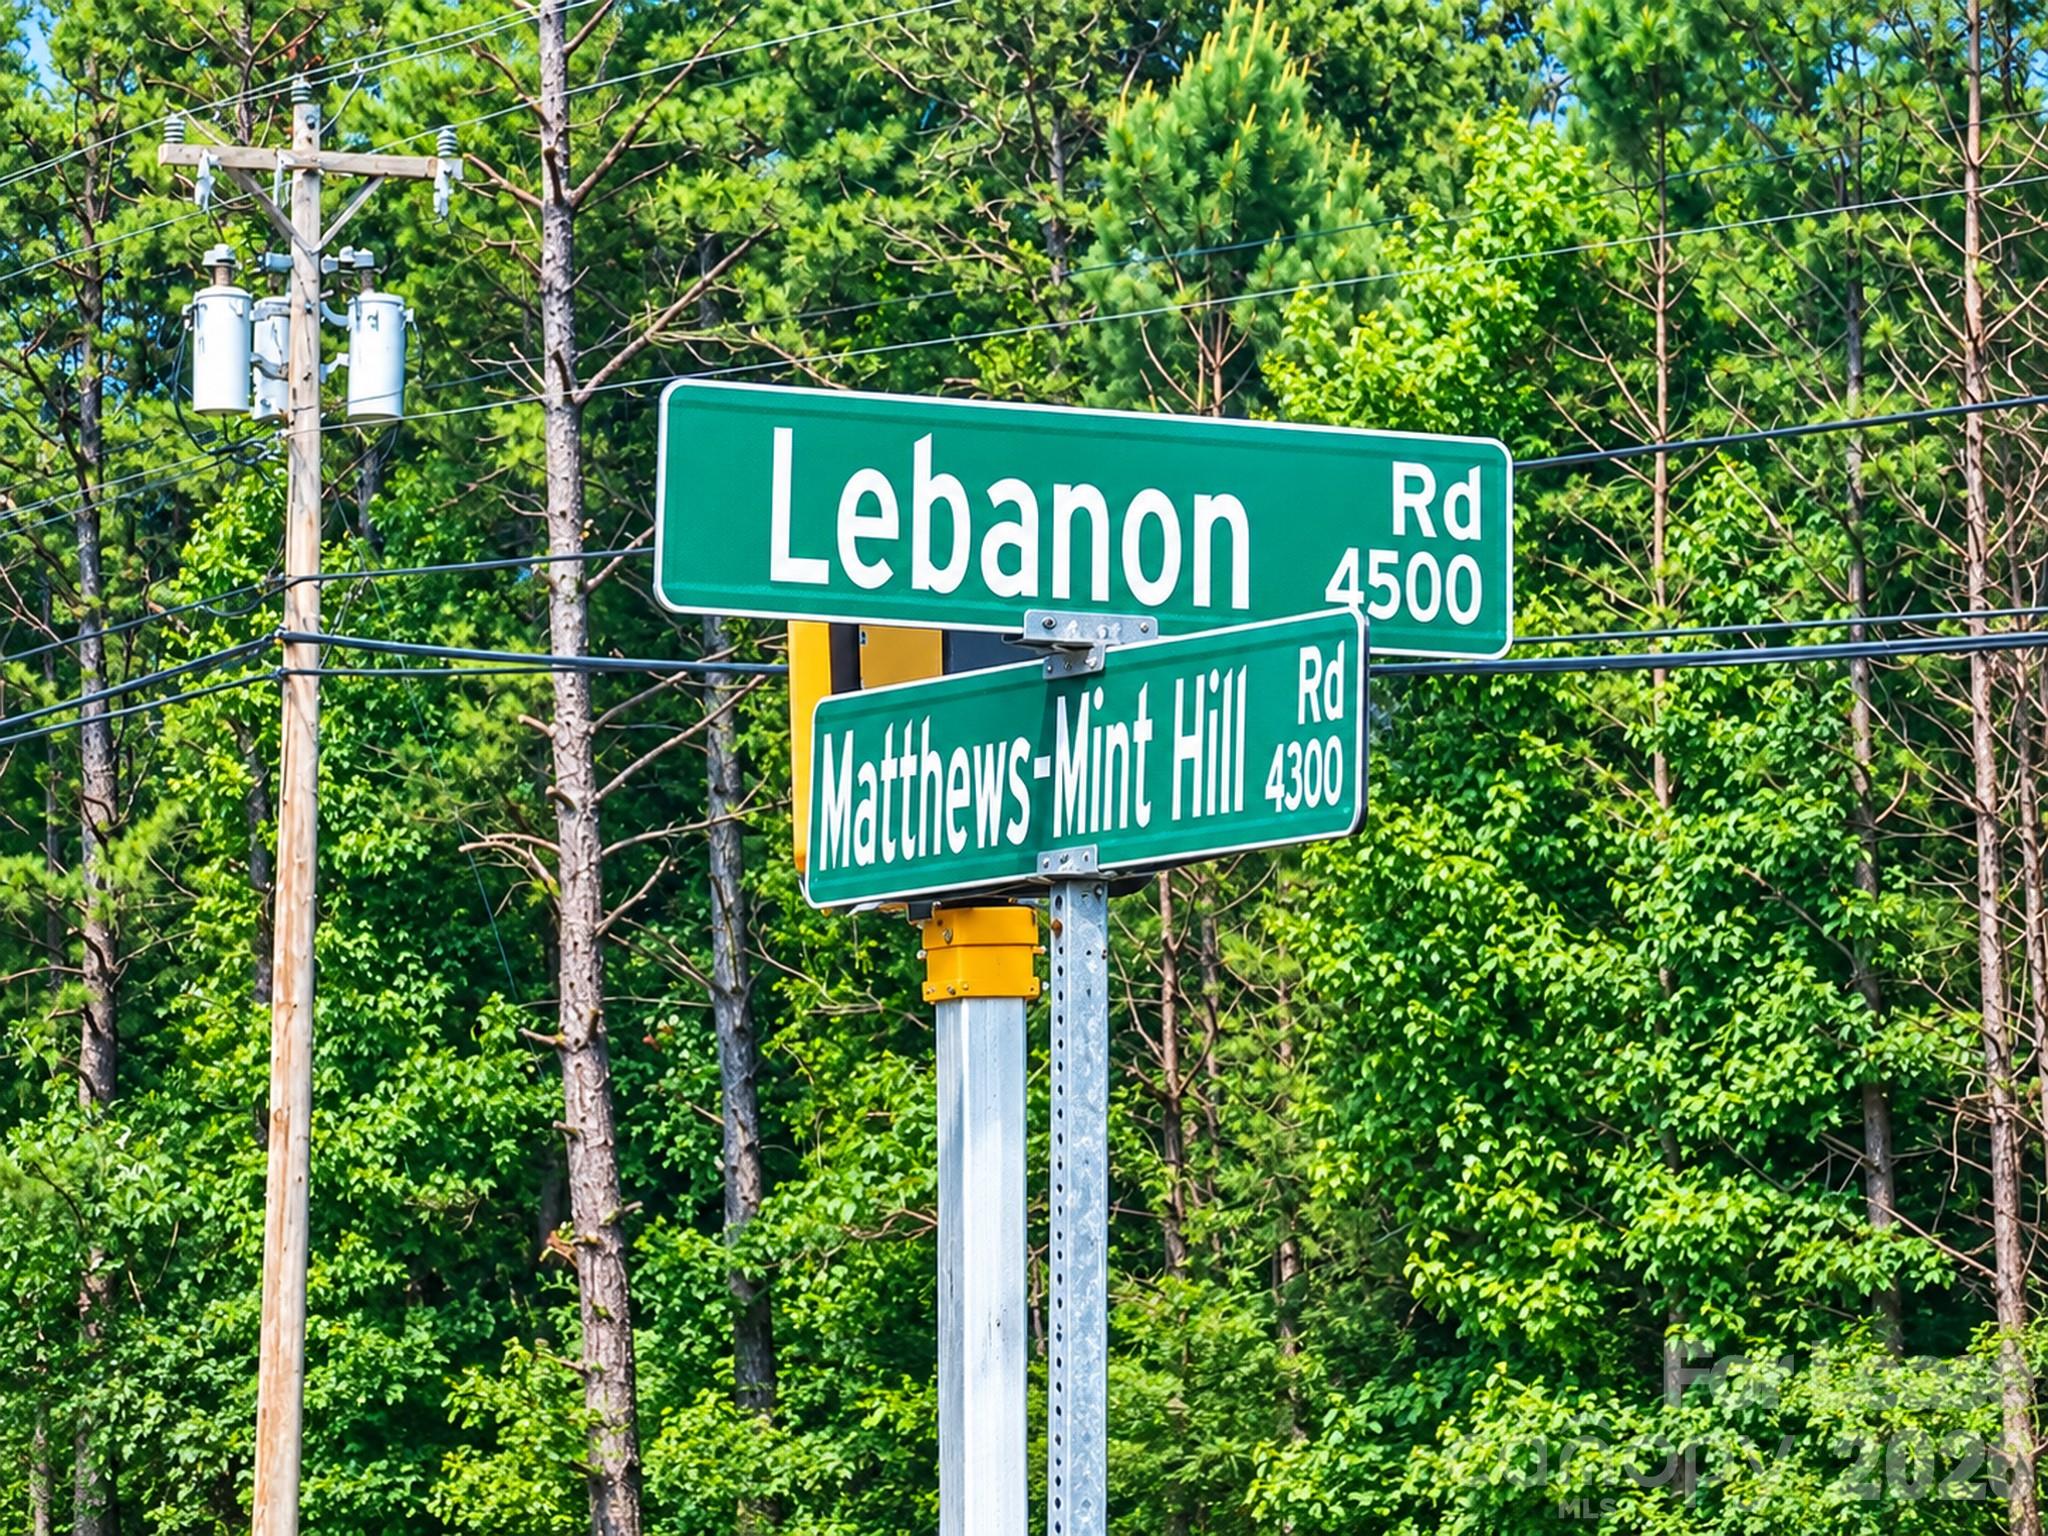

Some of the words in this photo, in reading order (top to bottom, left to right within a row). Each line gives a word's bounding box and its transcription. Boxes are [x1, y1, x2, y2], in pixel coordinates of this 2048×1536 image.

[770, 428, 1250, 609] Lebanon
[1392, 461, 1481, 541] Rd
[1325, 546, 1482, 625] 4500
[1298, 640, 1345, 725] Rd
[819, 683, 1153, 871] Matthews-Mint
[1172, 665, 1247, 821] Hill
[1265, 735, 1343, 813] 4300
